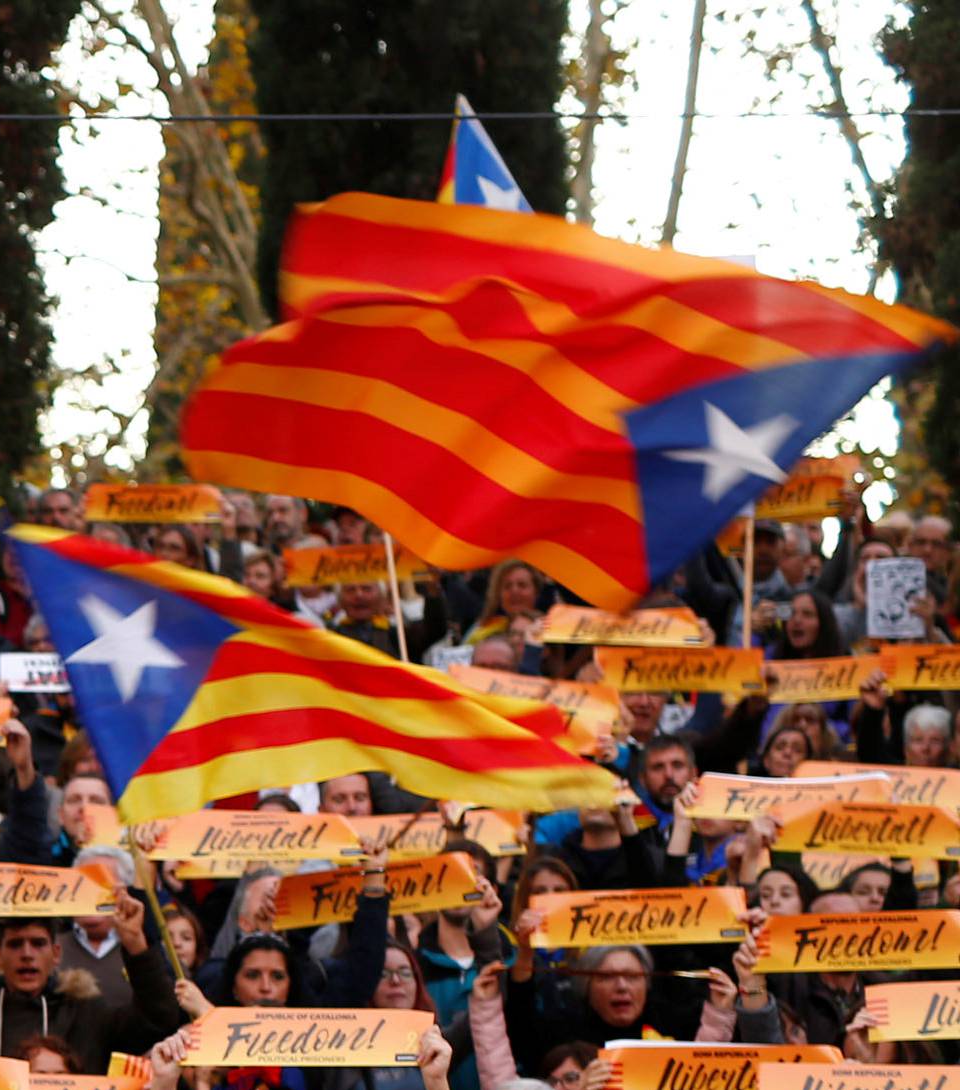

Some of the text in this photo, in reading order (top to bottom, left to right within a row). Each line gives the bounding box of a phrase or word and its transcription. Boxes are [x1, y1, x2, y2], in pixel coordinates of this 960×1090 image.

[192, 822, 328, 857] Llibertat!
[805, 811, 935, 848] Llibertat!
[570, 899, 707, 941] Freedom!
[793, 921, 942, 967] Freedom!
[223, 1020, 386, 1062] Freedom!
